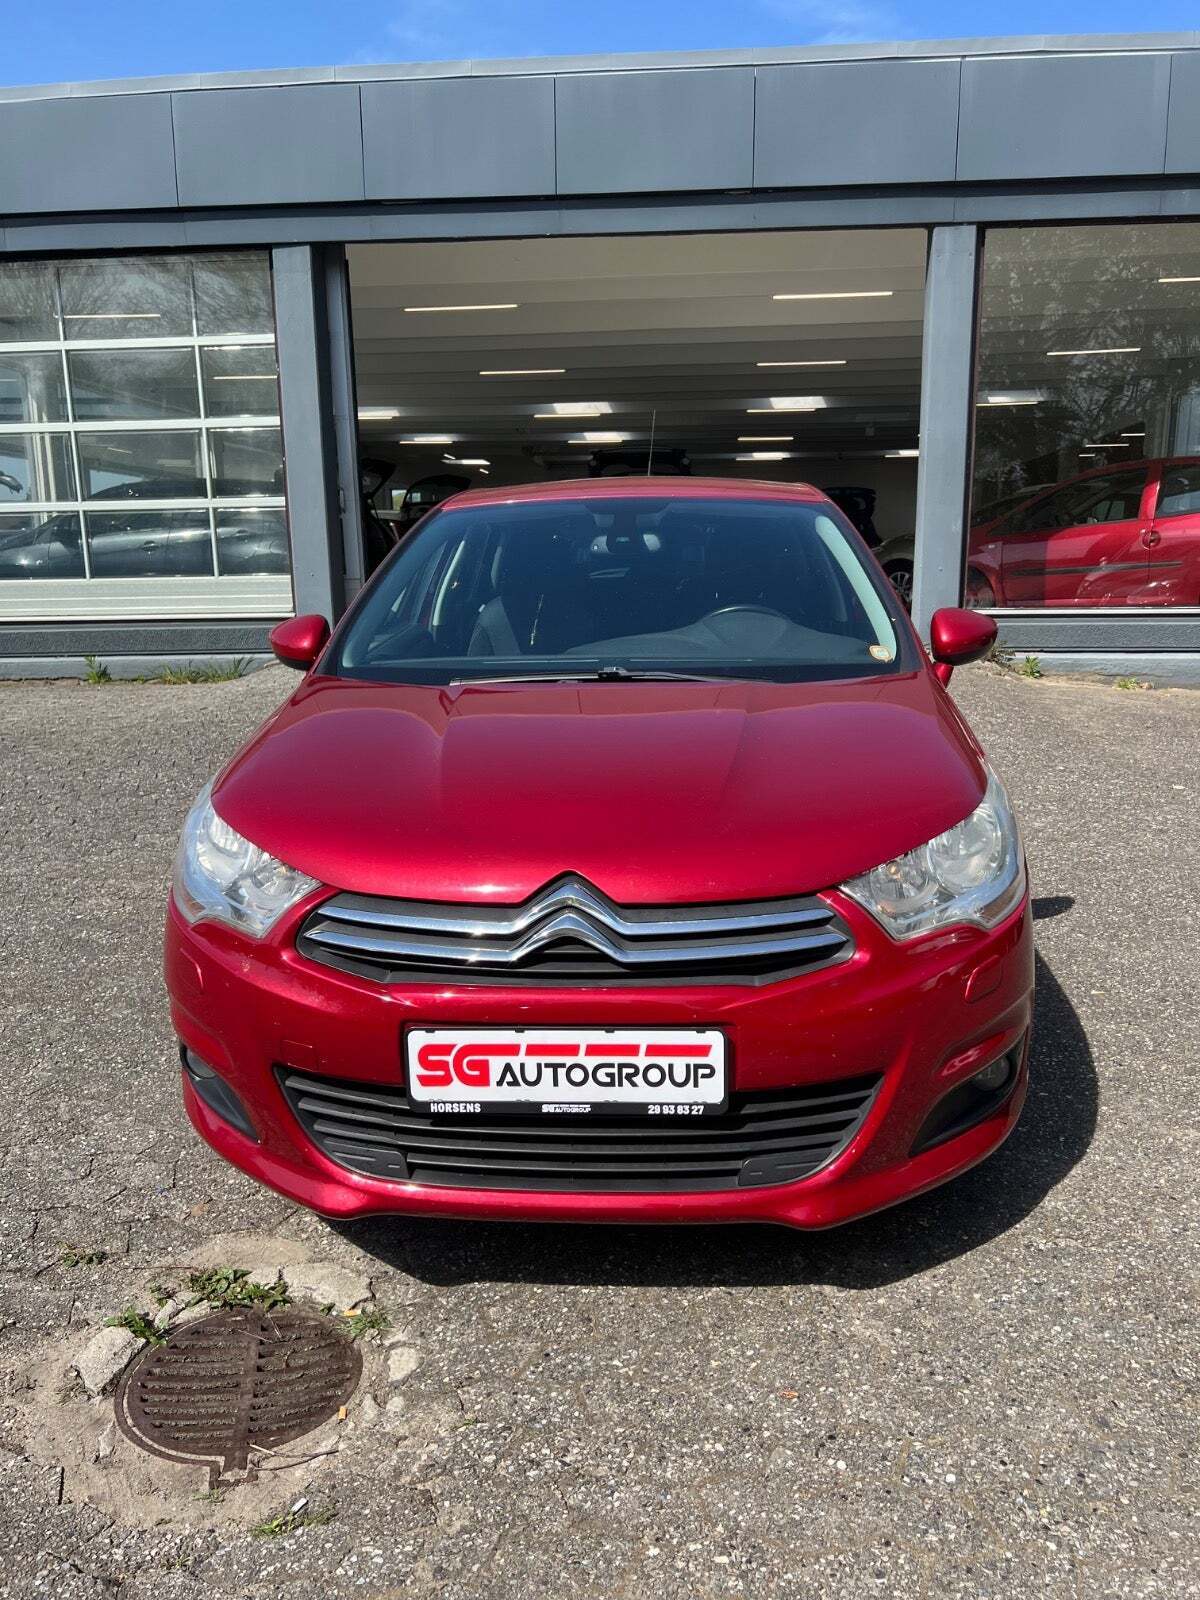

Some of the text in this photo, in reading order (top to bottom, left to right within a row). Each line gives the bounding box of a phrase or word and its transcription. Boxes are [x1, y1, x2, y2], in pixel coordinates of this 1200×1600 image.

[416, 1043, 716, 1088] SG AUTOGROUP
[430, 1102, 481, 1113] HORSENS
[648, 1104, 661, 1115] 29
[662, 1104, 675, 1115] 93
[691, 1105, 704, 1115] 27
